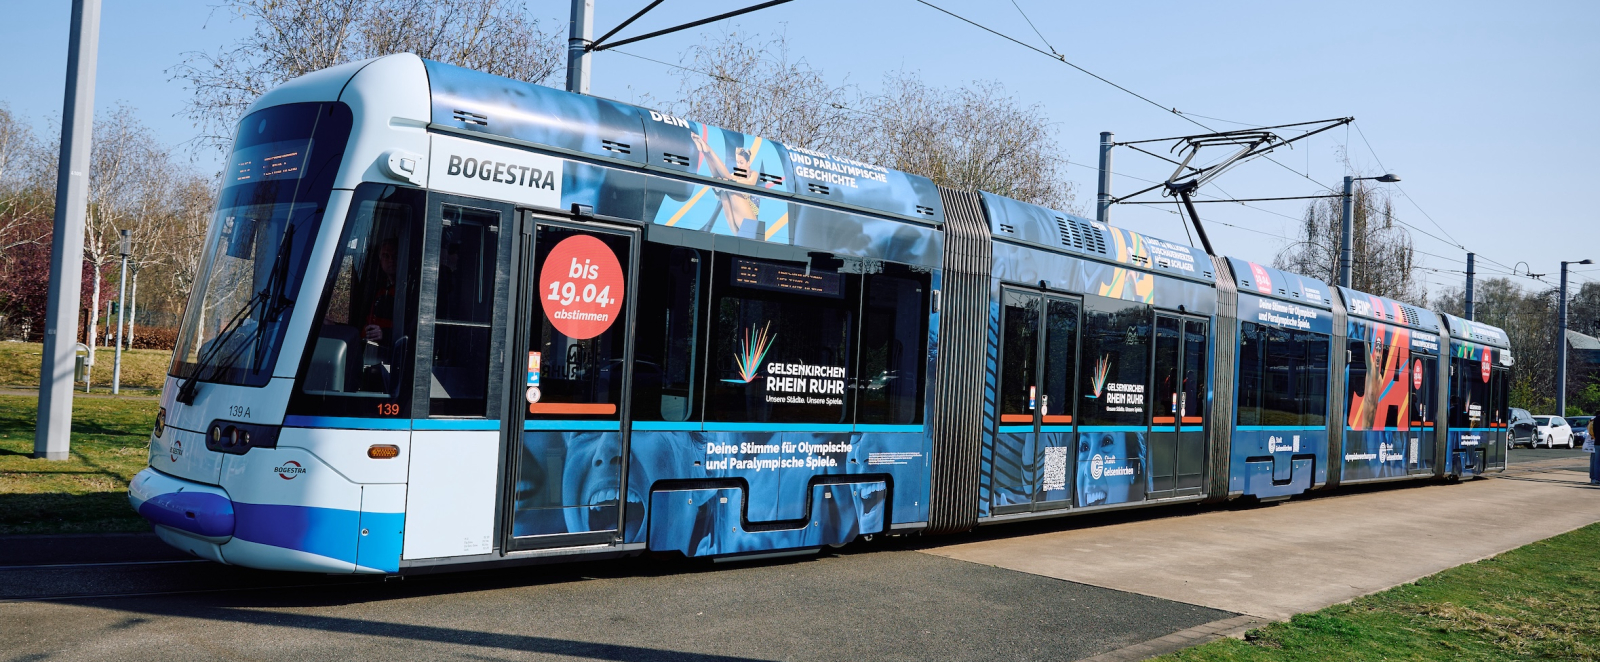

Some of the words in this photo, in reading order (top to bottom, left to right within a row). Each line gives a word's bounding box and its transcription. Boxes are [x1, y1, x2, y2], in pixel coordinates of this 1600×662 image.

[649, 110, 690, 129] DEIN
[447, 154, 555, 191] BOGESTRA
[789, 152, 812, 166] UND
[813, 157, 887, 183] PARALYMPISCHE
[796, 165, 858, 189] GESCHICHTE.
[568, 257, 599, 280] bis
[547, 281, 615, 308] 19.04.
[554, 308, 609, 322] abstimmen
[767, 362, 846, 378] GELSENKIRCHEN
[766, 376, 807, 393] RHEIN
[809, 378, 845, 395] RUHR
[1107, 382, 1145, 393] GELSENKIRCHEN
[765, 395, 786, 403] Unsere
[786, 395, 805, 404] Städte.
[806, 396, 826, 404] Unsere
[826, 397, 843, 406] Spiele.
[1106, 392, 1126, 404] RHEIN
[1126, 393, 1144, 405] RUHR
[229, 405, 243, 418] 139
[244, 406, 251, 418] A
[377, 403, 399, 416] 139
[706, 442, 738, 455] Deine
[739, 442, 780, 454] Stimme
[782, 441, 795, 454] für
[798, 441, 853, 456] Olympische
[706, 457, 727, 470] und
[729, 456, 805, 471] Paralympische
[805, 455, 838, 470] Spiele.
[1104, 454, 1116, 464] Stadt
[274, 466, 307, 474] BOGESTRA
[1103, 466, 1134, 477] Gelsenkirchen
